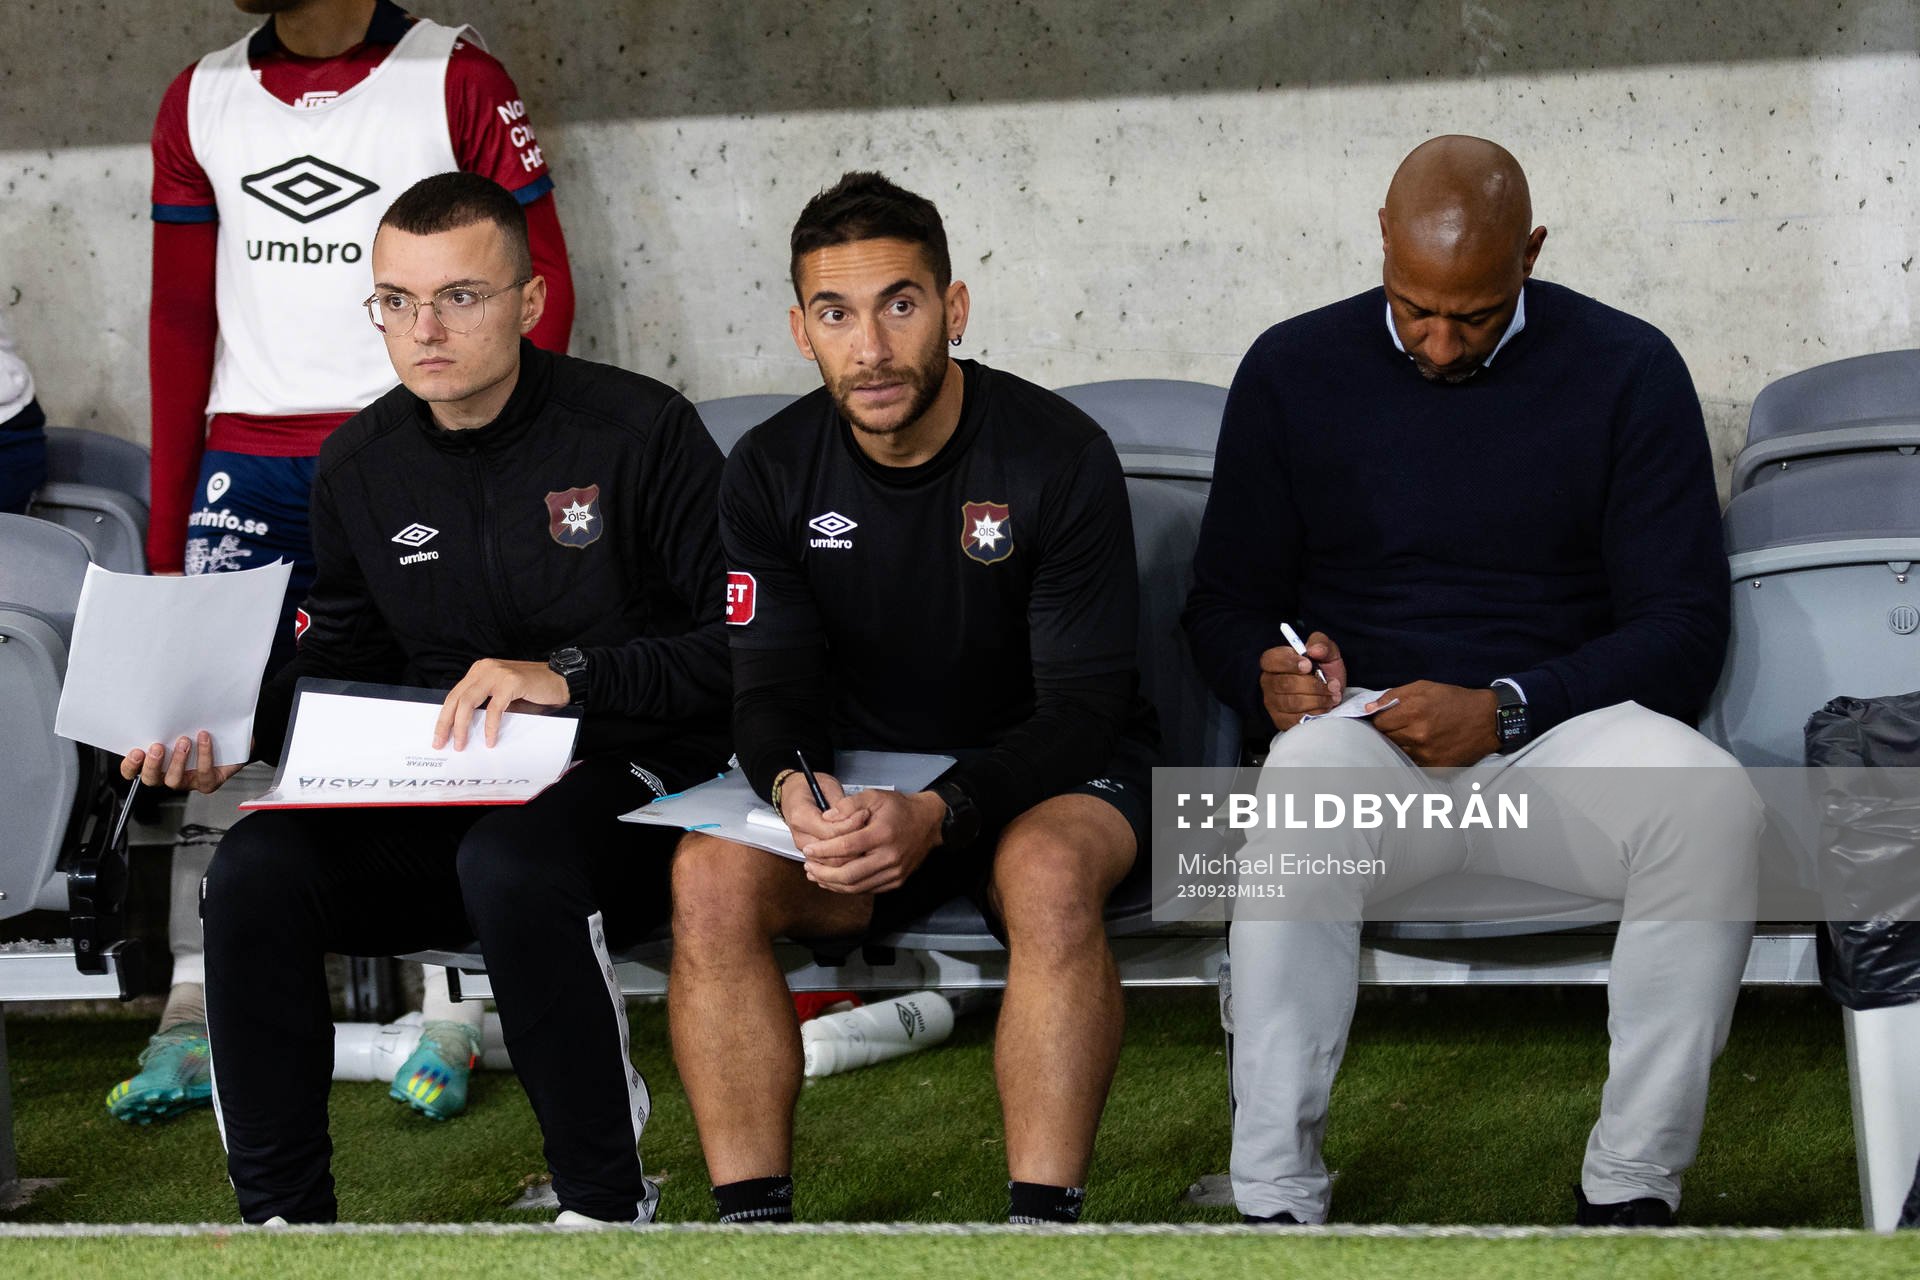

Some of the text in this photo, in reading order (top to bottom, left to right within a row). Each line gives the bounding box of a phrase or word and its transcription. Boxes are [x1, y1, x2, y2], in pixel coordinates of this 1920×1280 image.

[246, 236, 363, 264] umbro
[568, 510, 587, 522] ÖIS
[978, 525, 996, 537] ÖIS
[810, 536, 853, 549] umbro
[399, 550, 440, 566] umbro
